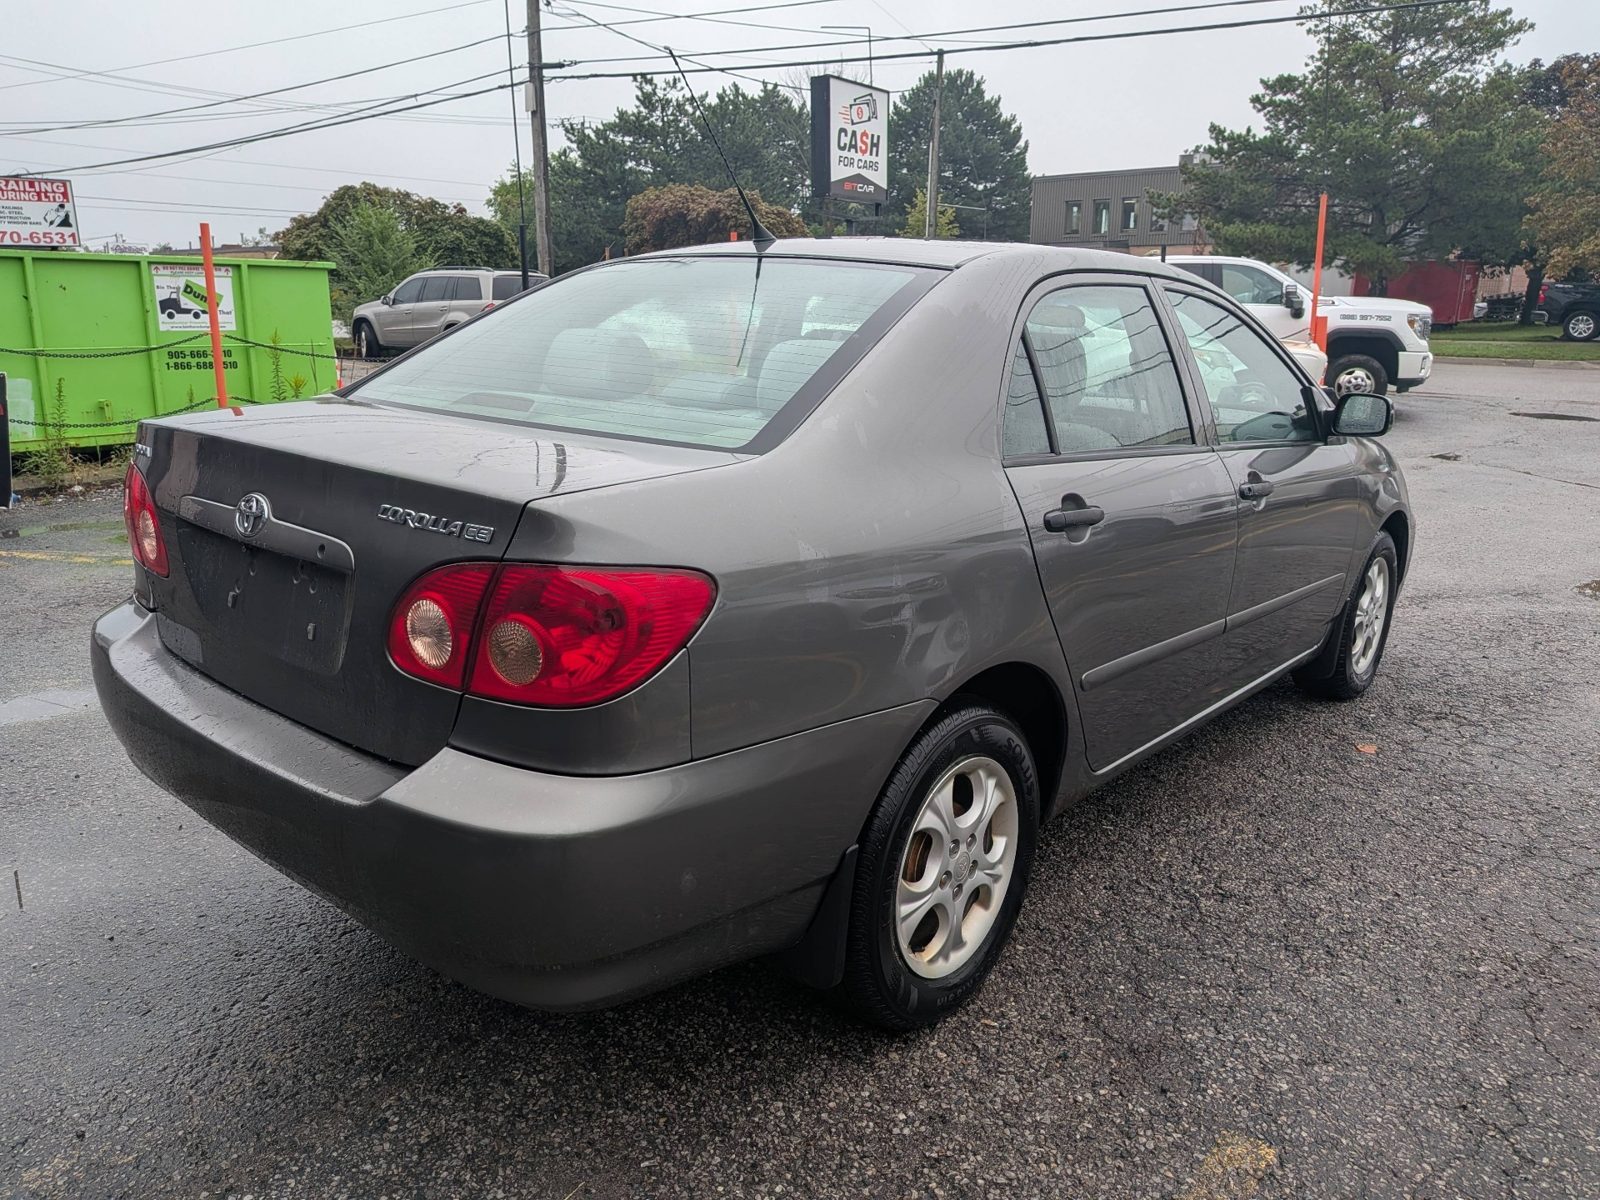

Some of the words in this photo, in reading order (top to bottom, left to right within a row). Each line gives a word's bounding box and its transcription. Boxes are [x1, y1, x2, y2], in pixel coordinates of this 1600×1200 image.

[838, 128, 880, 157] CA$H
[838, 156, 855, 168] FOR
[857, 159, 879, 172] CARS
[844, 182, 874, 192] BITCAR
[41, 193, 67, 202] LTD.
[377, 504, 463, 537] COROLLA
[464, 524, 494, 544] CE
